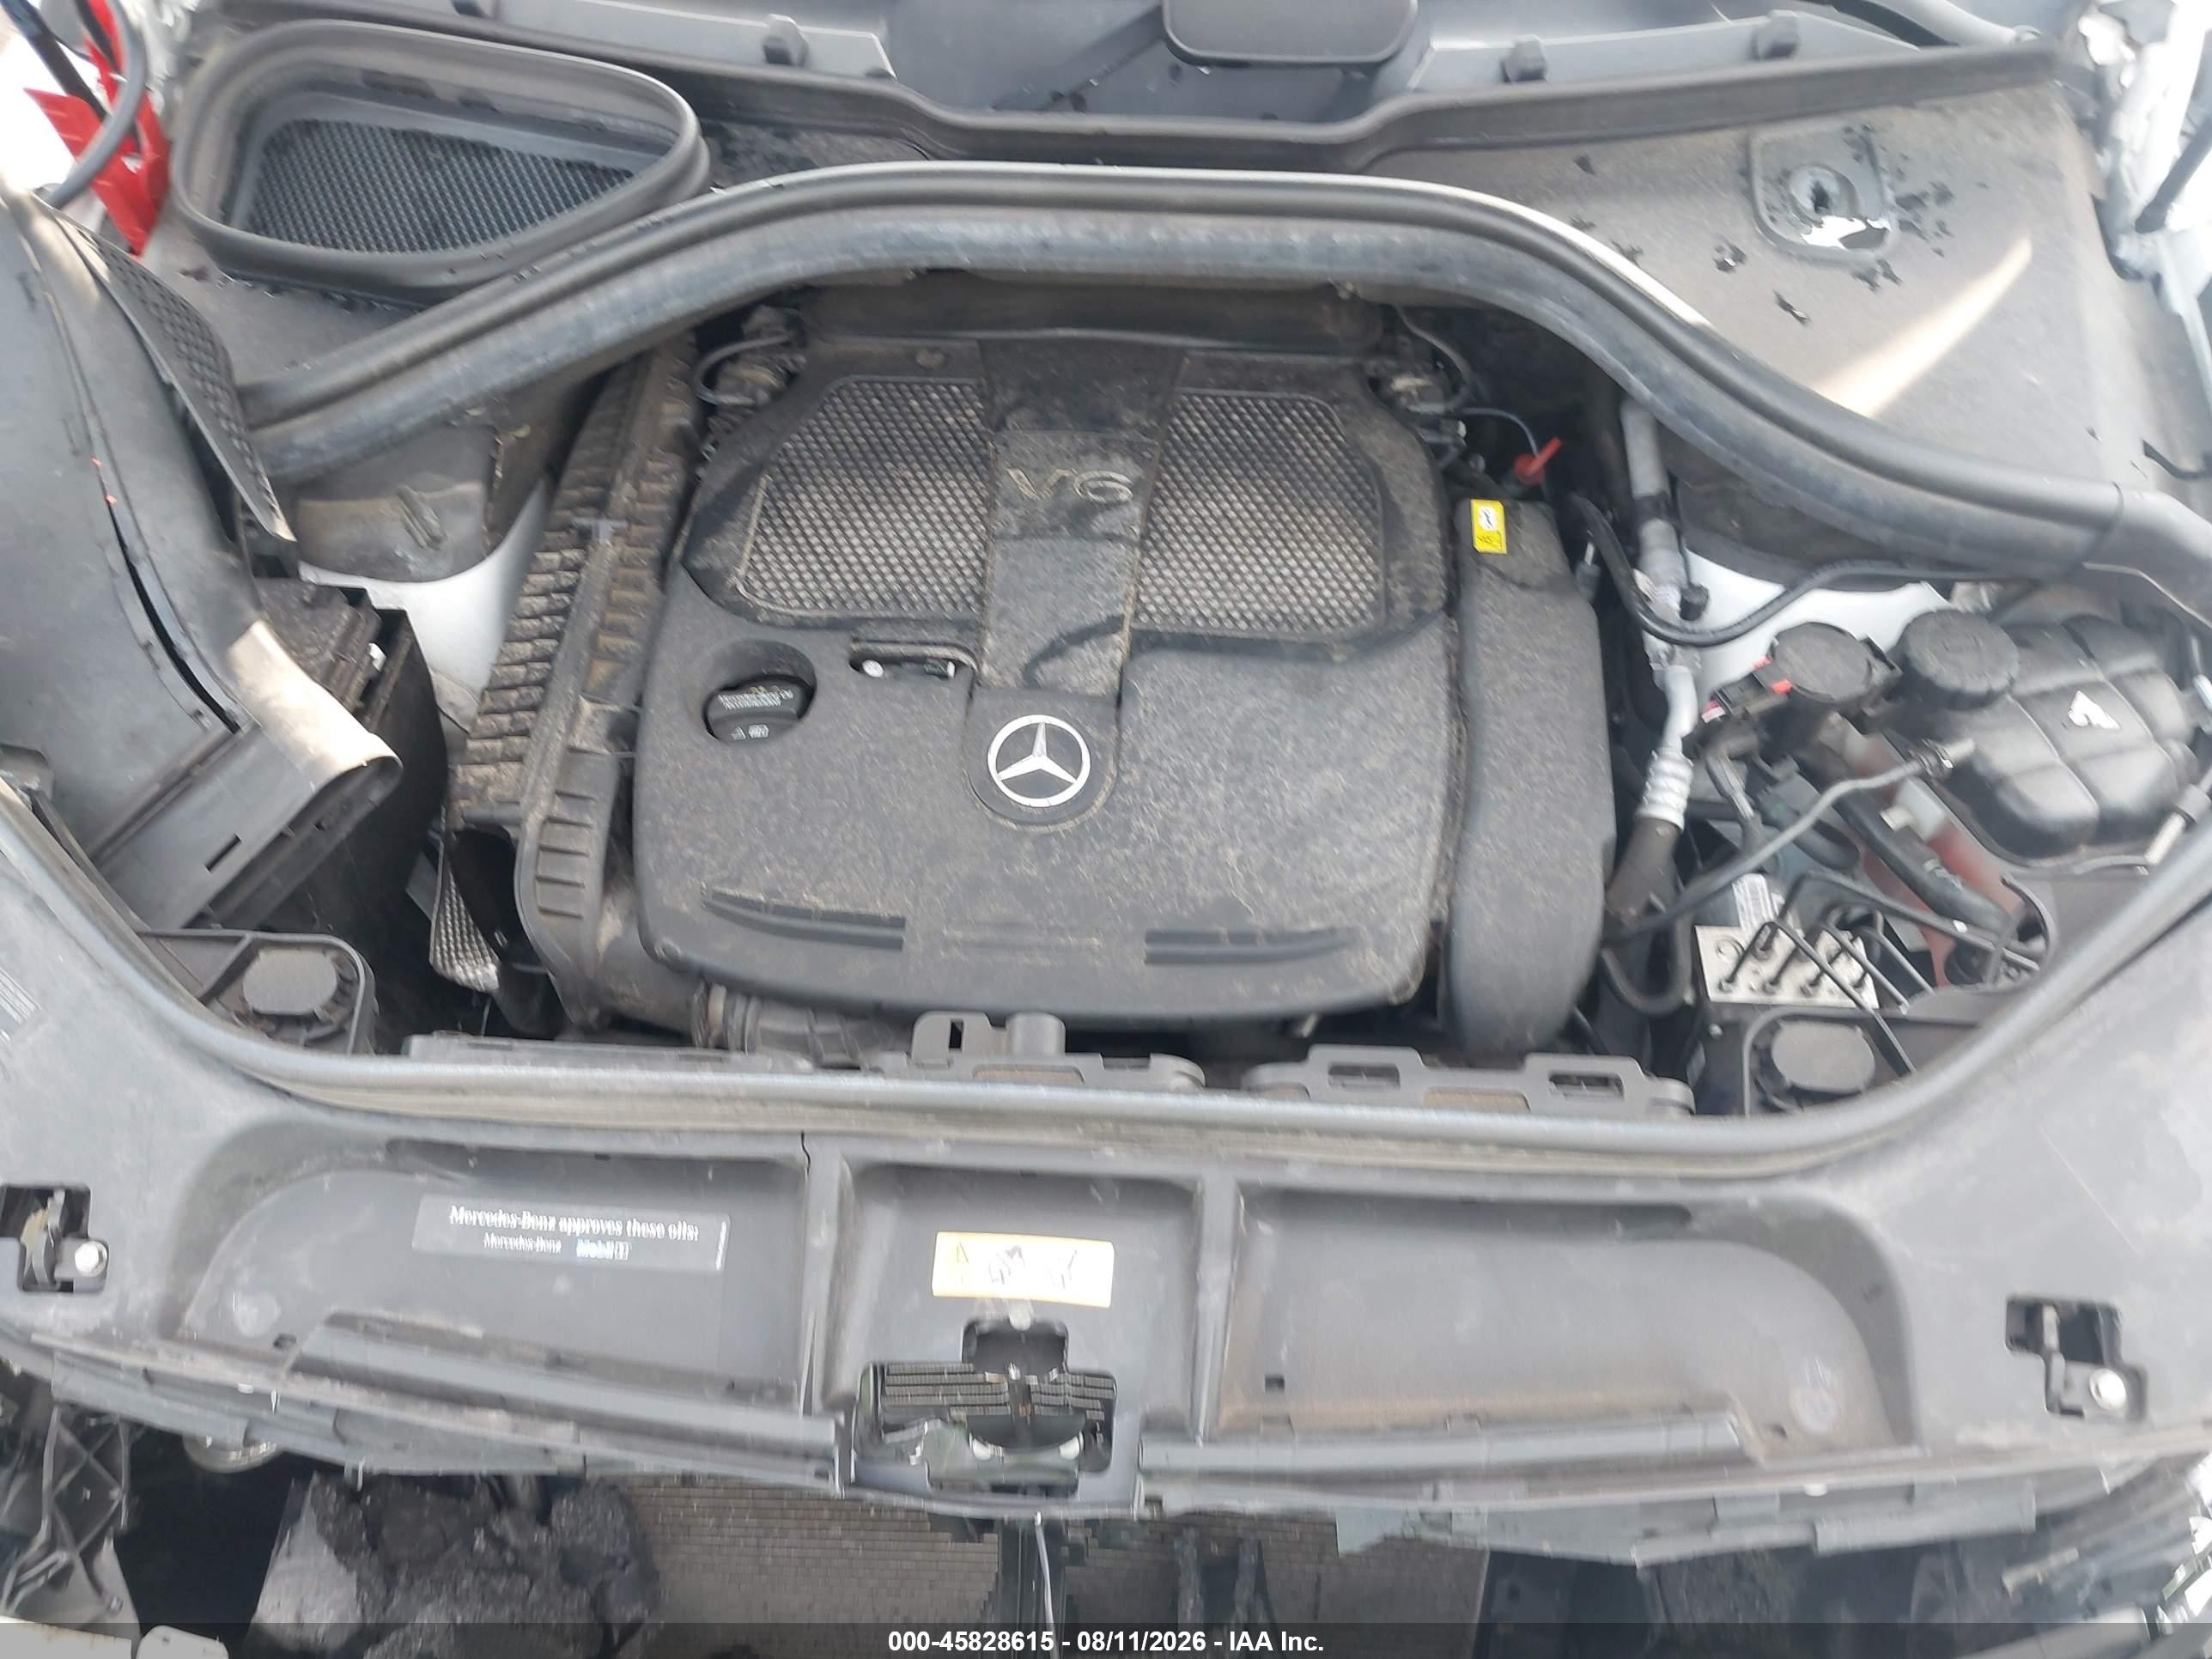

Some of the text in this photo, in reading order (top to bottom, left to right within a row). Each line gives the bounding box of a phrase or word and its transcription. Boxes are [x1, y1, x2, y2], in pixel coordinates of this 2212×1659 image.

[1006, 467, 1133, 503] V6
[449, 1206, 699, 1242] Mercedes-Benz approves these oils:
[483, 1232, 562, 1254] Mercedes-Benz
